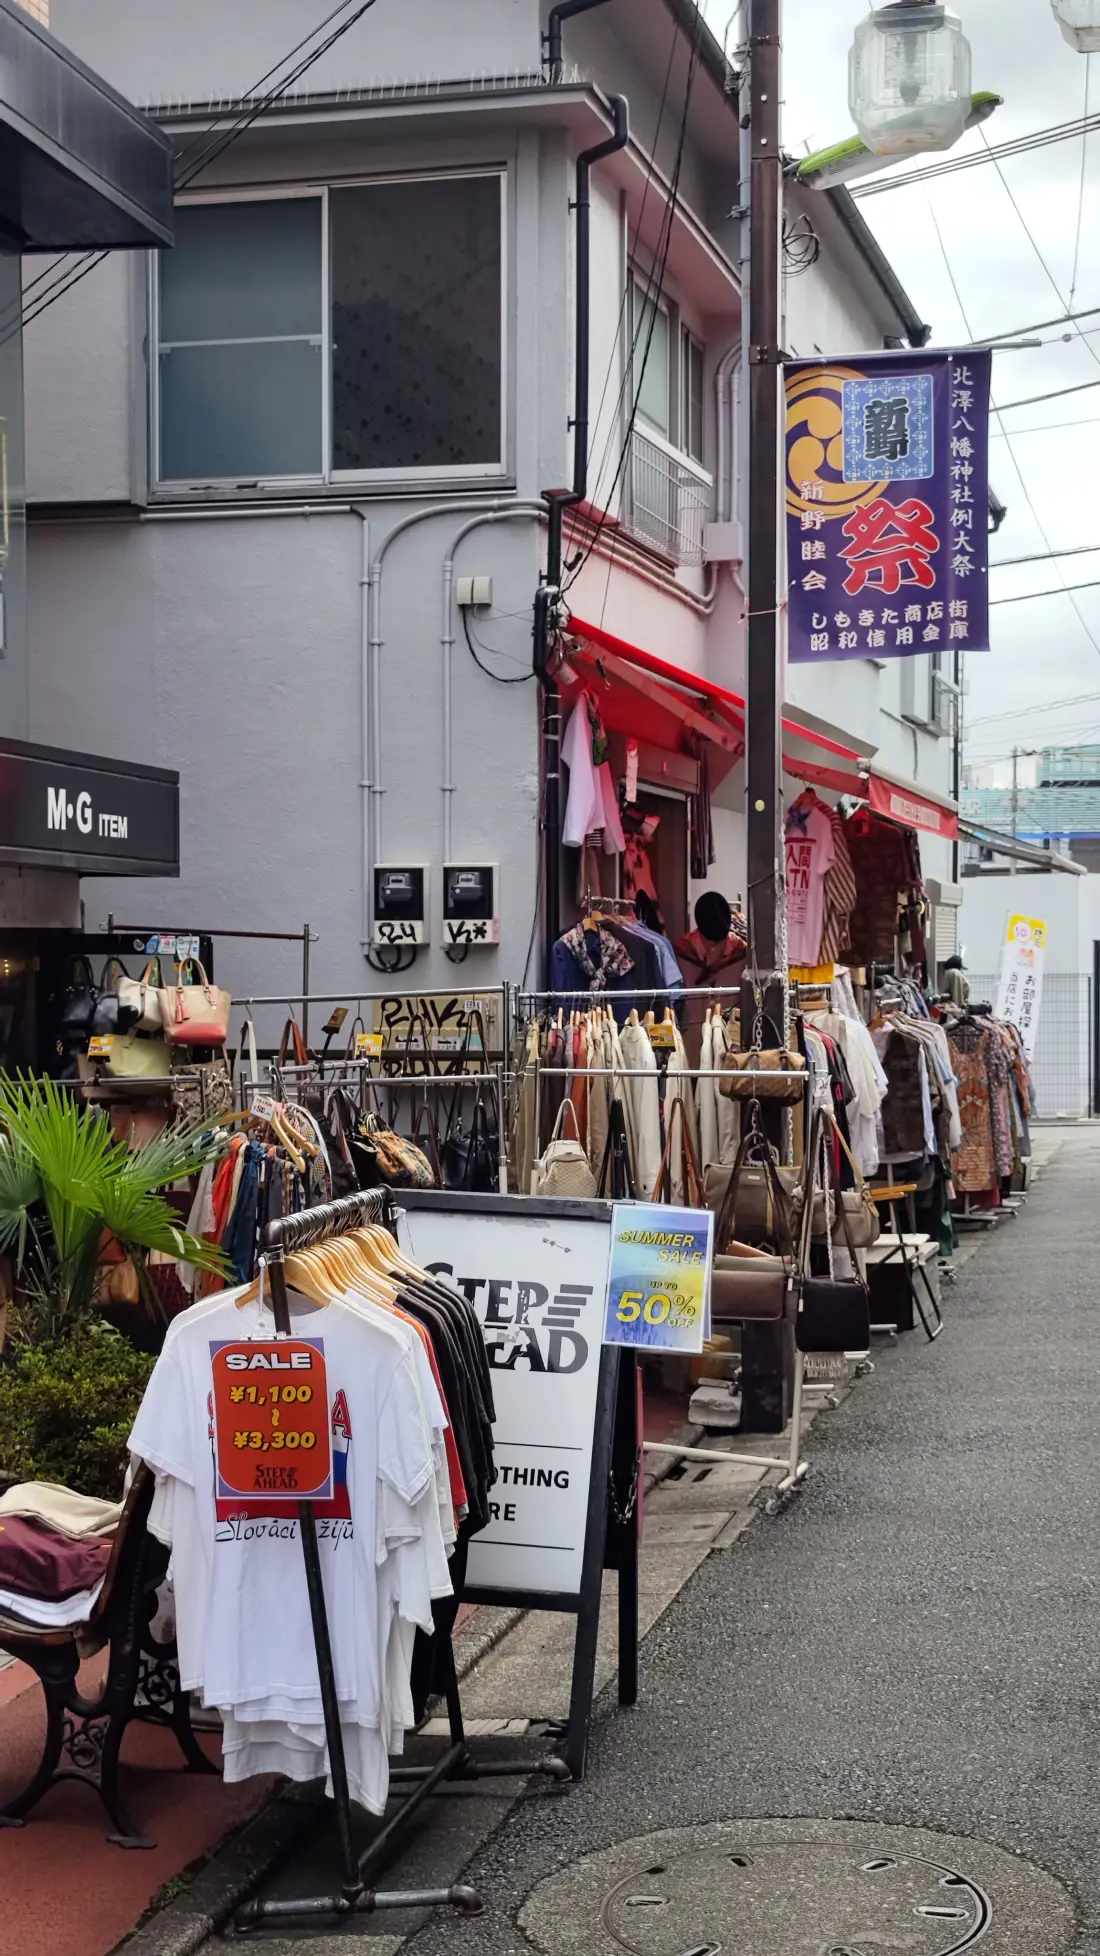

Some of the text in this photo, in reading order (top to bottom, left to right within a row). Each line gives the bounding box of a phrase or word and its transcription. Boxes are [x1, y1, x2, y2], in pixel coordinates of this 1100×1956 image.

[950, 366, 976, 577] 北澤八幡神社例大祭
[800, 480, 827, 591] 新野睦会
[837, 498, 940, 596] 祭
[811, 600, 969, 630] しもきた商店街
[810, 620, 969, 651] 昭和信用金庫
[99, 813, 128, 839] ITEM
[786, 844, 812, 869] 人間
[619, 1230, 695, 1248] SUMMER
[657, 1249, 703, 1265] SALE
[648, 1281, 678, 1290] UP TO
[615, 1291, 697, 1326] 50%
[667, 1317, 694, 1328] OFF
[225, 1353, 312, 1370] SALE
[230, 1385, 312, 1405] ¥1,100
[234, 1431, 315, 1451] ¥3,300
[494, 1466, 570, 1489] THING
